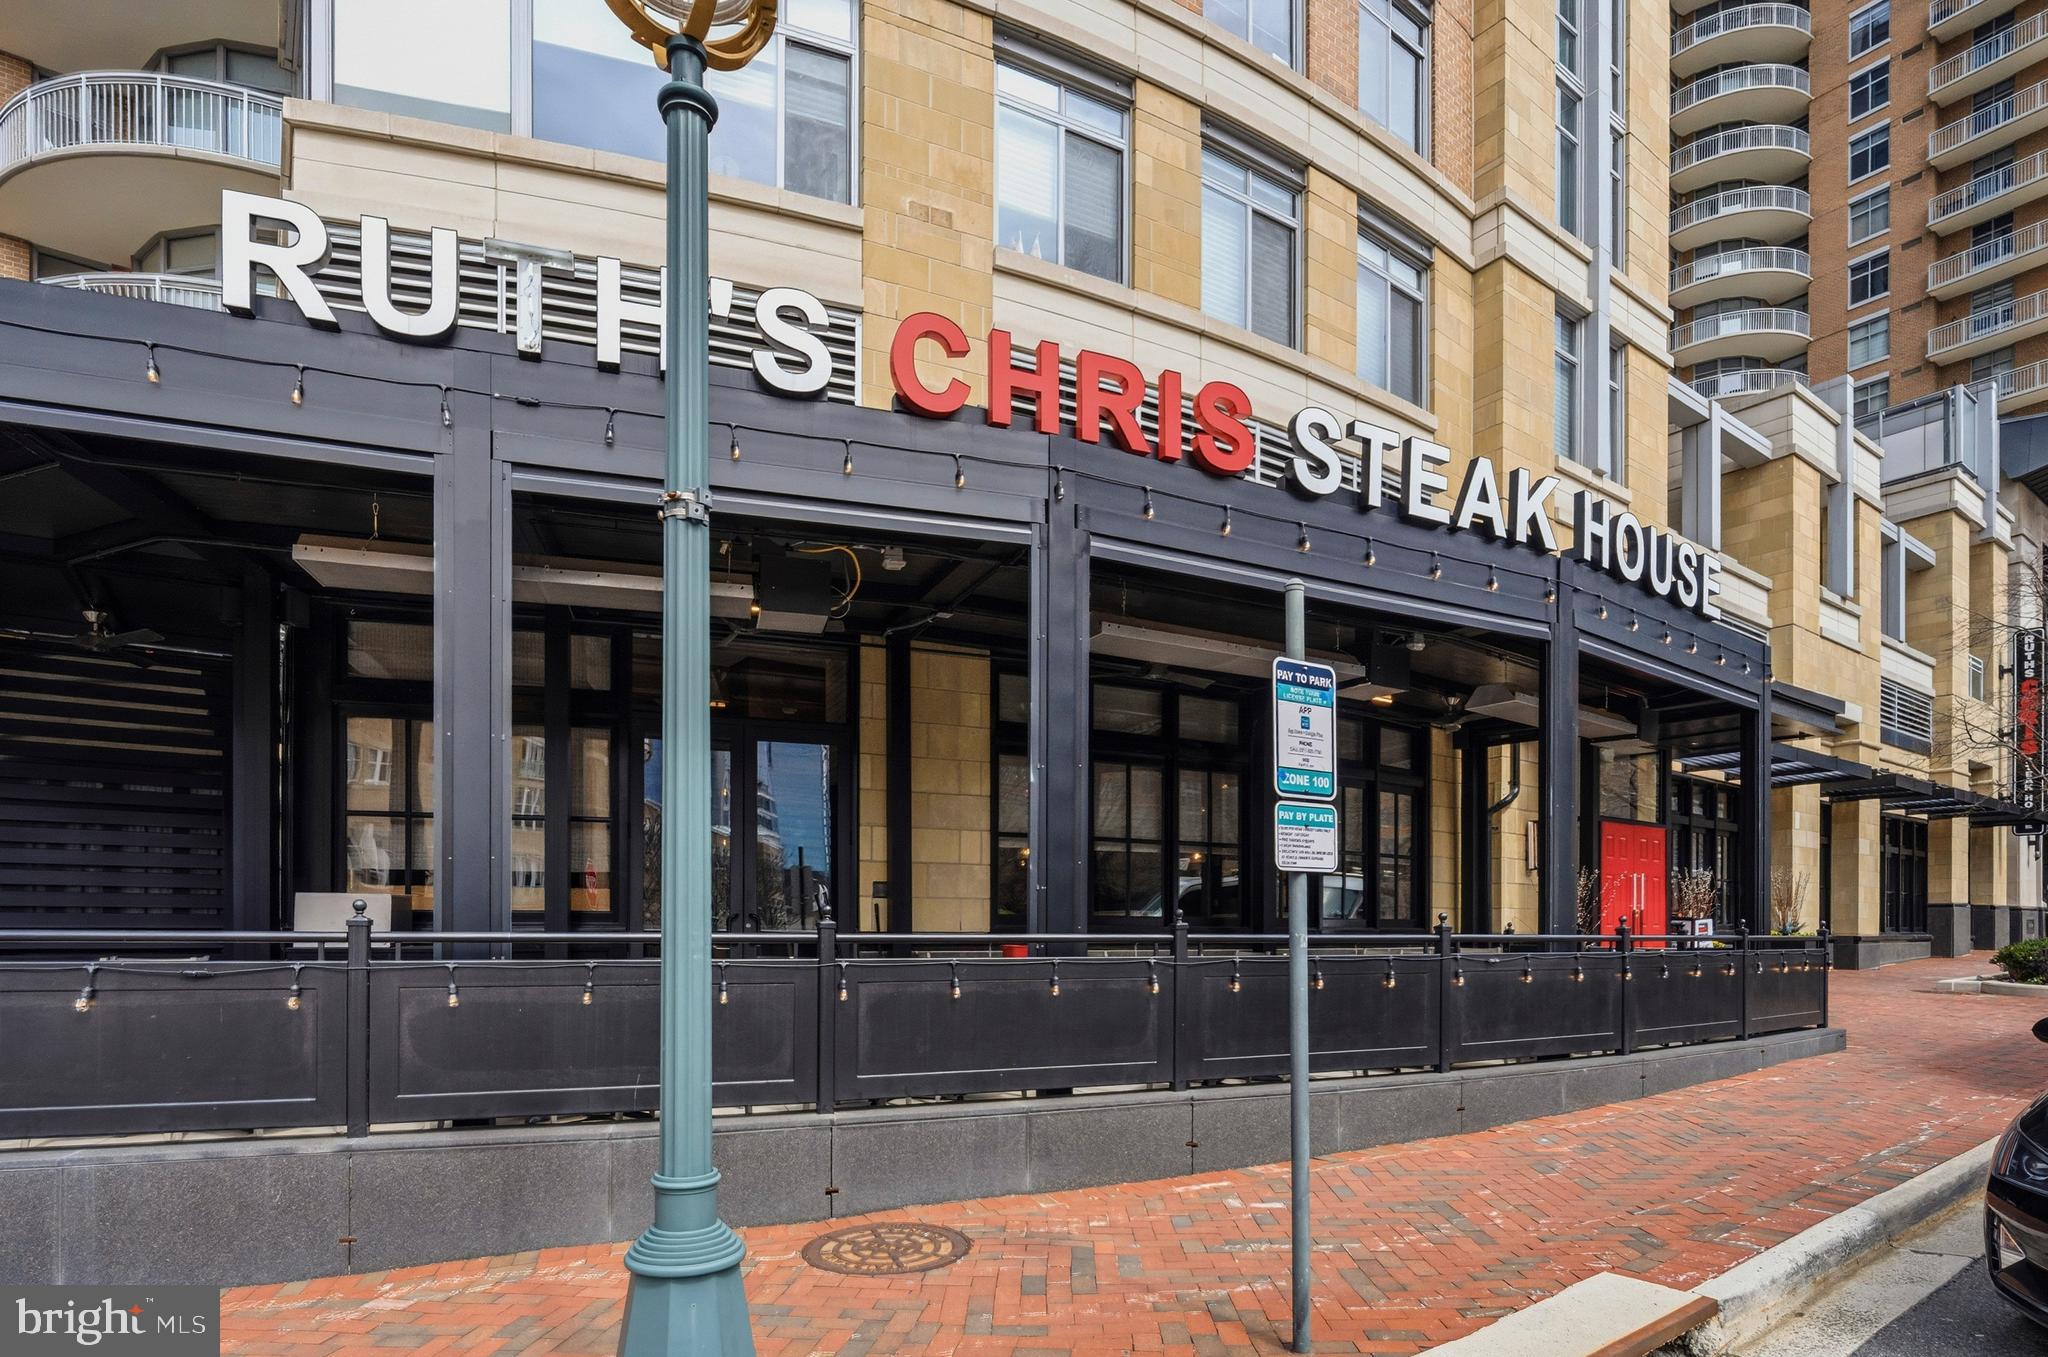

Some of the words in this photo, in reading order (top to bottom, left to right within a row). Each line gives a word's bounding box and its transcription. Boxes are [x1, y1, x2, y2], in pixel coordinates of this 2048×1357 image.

[221, 189, 833, 398] RUTH'S
[890, 311, 1255, 476] CHRIS
[1286, 406, 1561, 552] STEAK
[1573, 489, 1722, 621] HOUSE
[1277, 669, 1294, 681] PAY
[1295, 672, 1307, 684] TO
[1309, 675, 1332, 688] PARK
[1282, 773, 1310, 787] ZONE
[1312, 777, 1330, 788] 100
[1279, 810, 1294, 821] PAY
[1296, 812, 1307, 822] BY
[1309, 813, 1334, 823] PLATE
